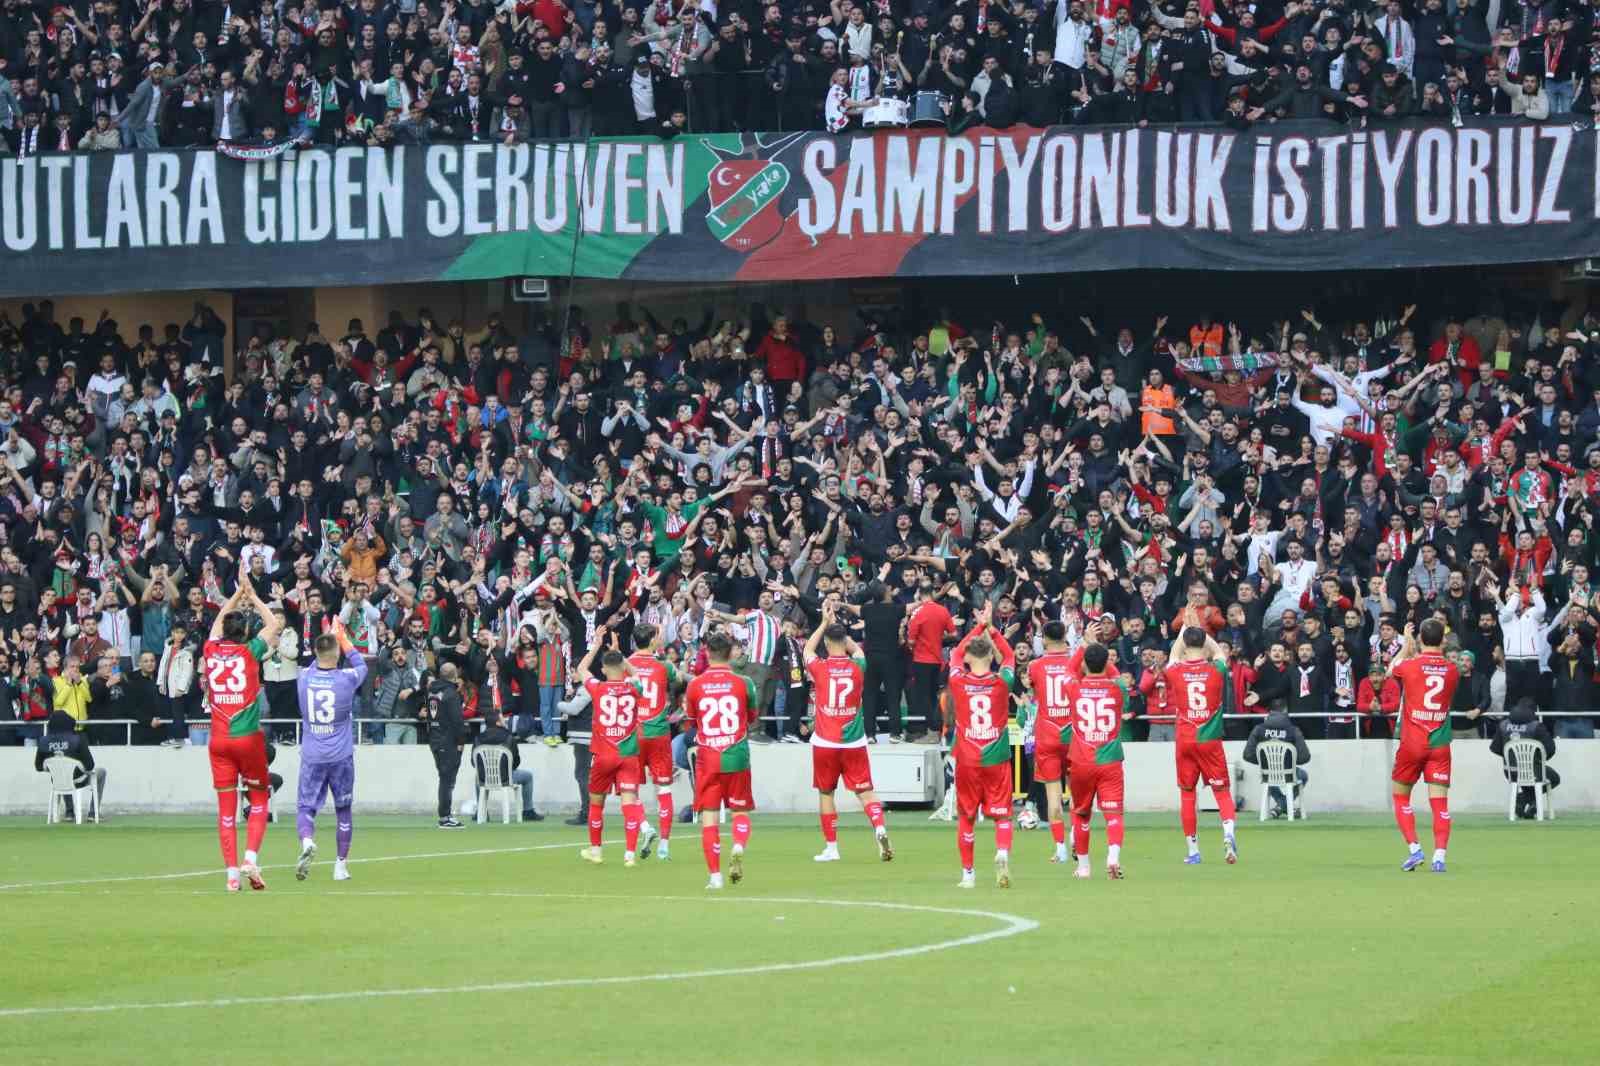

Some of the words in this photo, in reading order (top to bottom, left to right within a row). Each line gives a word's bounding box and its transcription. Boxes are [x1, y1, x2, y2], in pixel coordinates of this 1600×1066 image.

[1, 153, 226, 251] UTLARA
[207, 656, 247, 692] 23
[1046, 674, 1070, 706] 10
[307, 688, 336, 723] 13
[828, 677, 854, 707] 17
[1187, 681, 1207, 710] 6
[1424, 676, 1444, 710] 2
[599, 695, 636, 727] 93
[699, 695, 739, 735] 28
[969, 694, 992, 729] 8
[1076, 698, 1116, 732] 95
